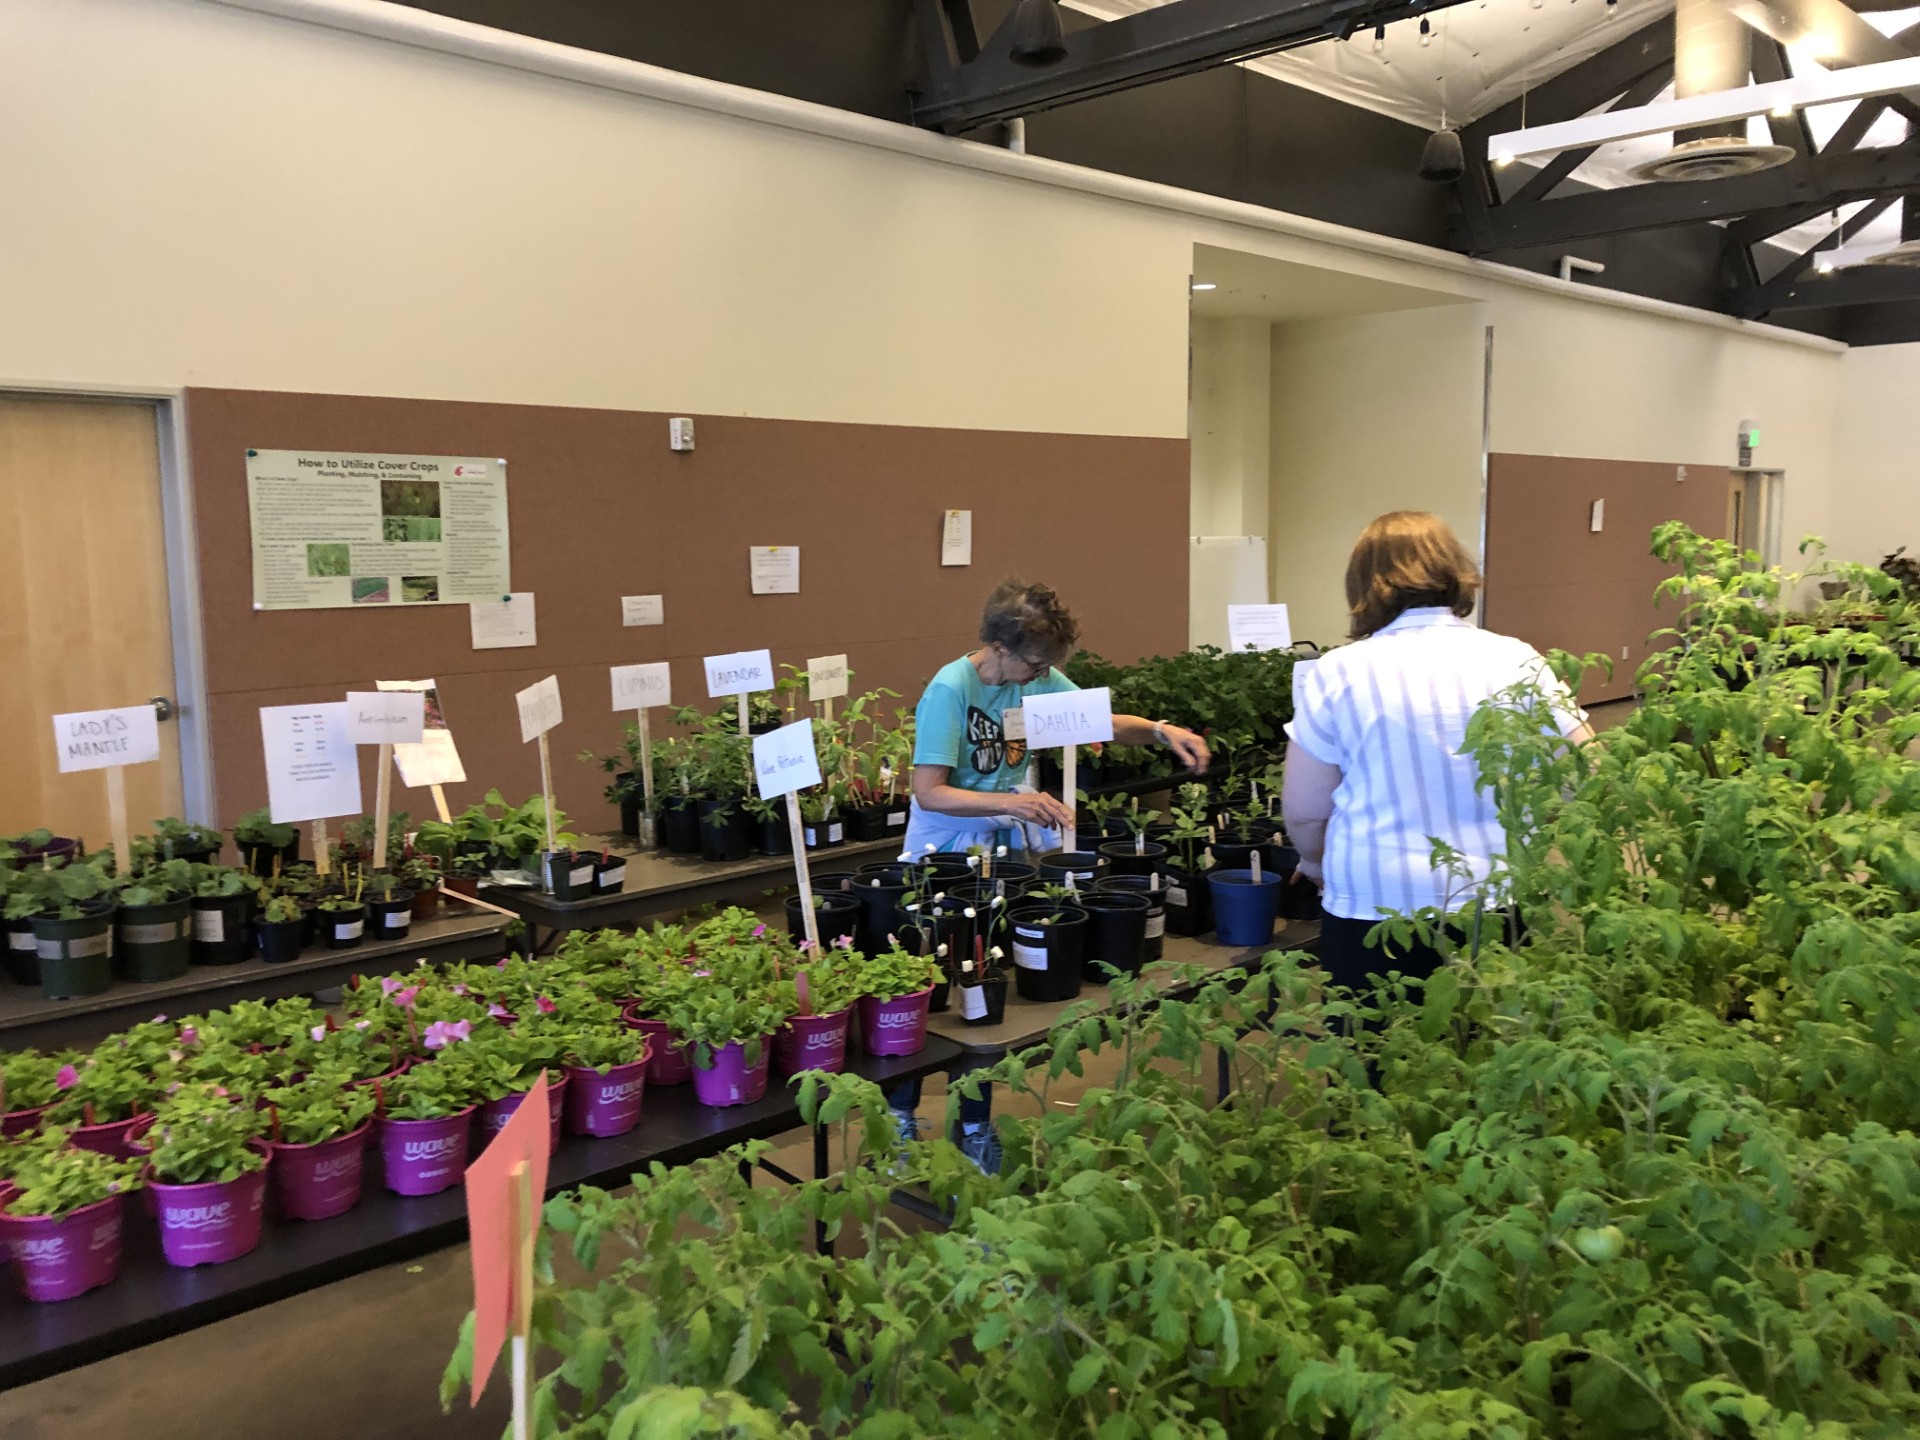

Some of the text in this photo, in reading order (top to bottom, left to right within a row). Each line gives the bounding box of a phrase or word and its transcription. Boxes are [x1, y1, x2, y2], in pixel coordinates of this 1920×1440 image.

[297, 458, 440, 472] How to Utilize Cover Crops
[70, 713, 128, 738] LADY'S
[968, 712, 1000, 741] KEEP
[1033, 711, 1091, 736] DAHLIA
[68, 735, 129, 760] MANTLE
[976, 742, 1002, 771] WILD
[879, 1009, 921, 1023] wave
[404, 1133, 461, 1154] wave
